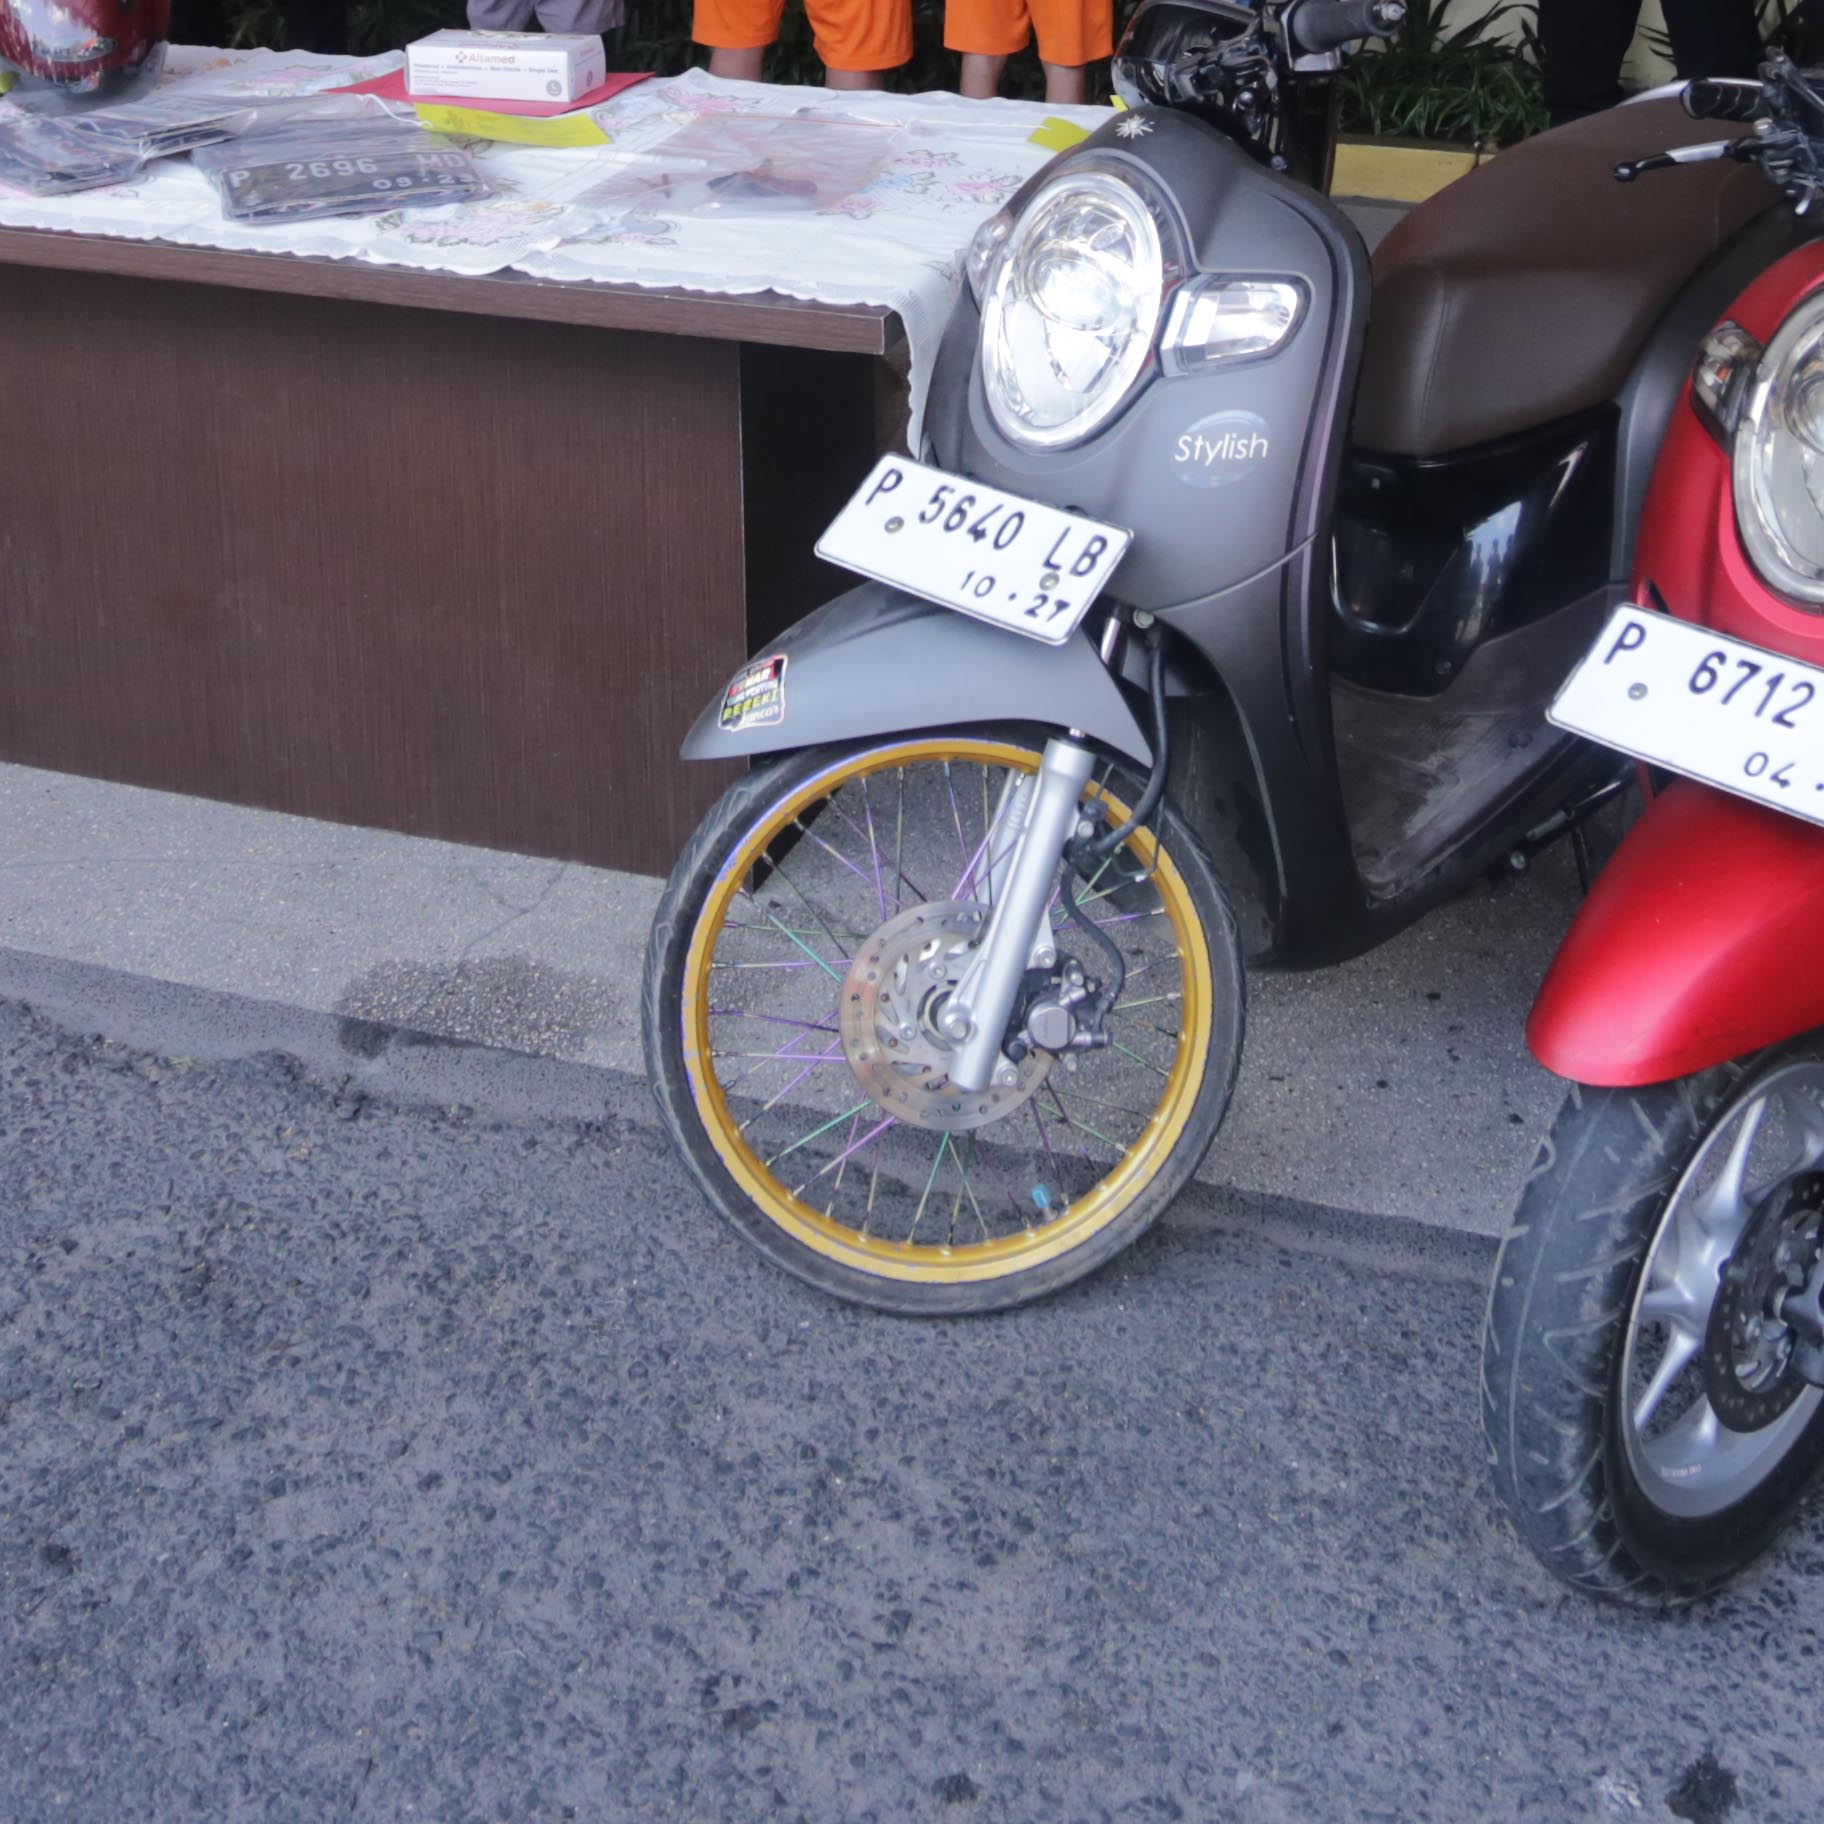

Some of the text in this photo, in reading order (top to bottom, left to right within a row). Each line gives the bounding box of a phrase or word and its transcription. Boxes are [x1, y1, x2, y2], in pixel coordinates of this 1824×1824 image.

[230, 170, 251, 189] P
[284, 157, 377, 180] 2696
[1173, 433, 1269, 465] Stylish
[866, 468, 1109, 578] P 5640 LB
[1603, 622, 1646, 666] P
[1686, 652, 1816, 730] 6712
